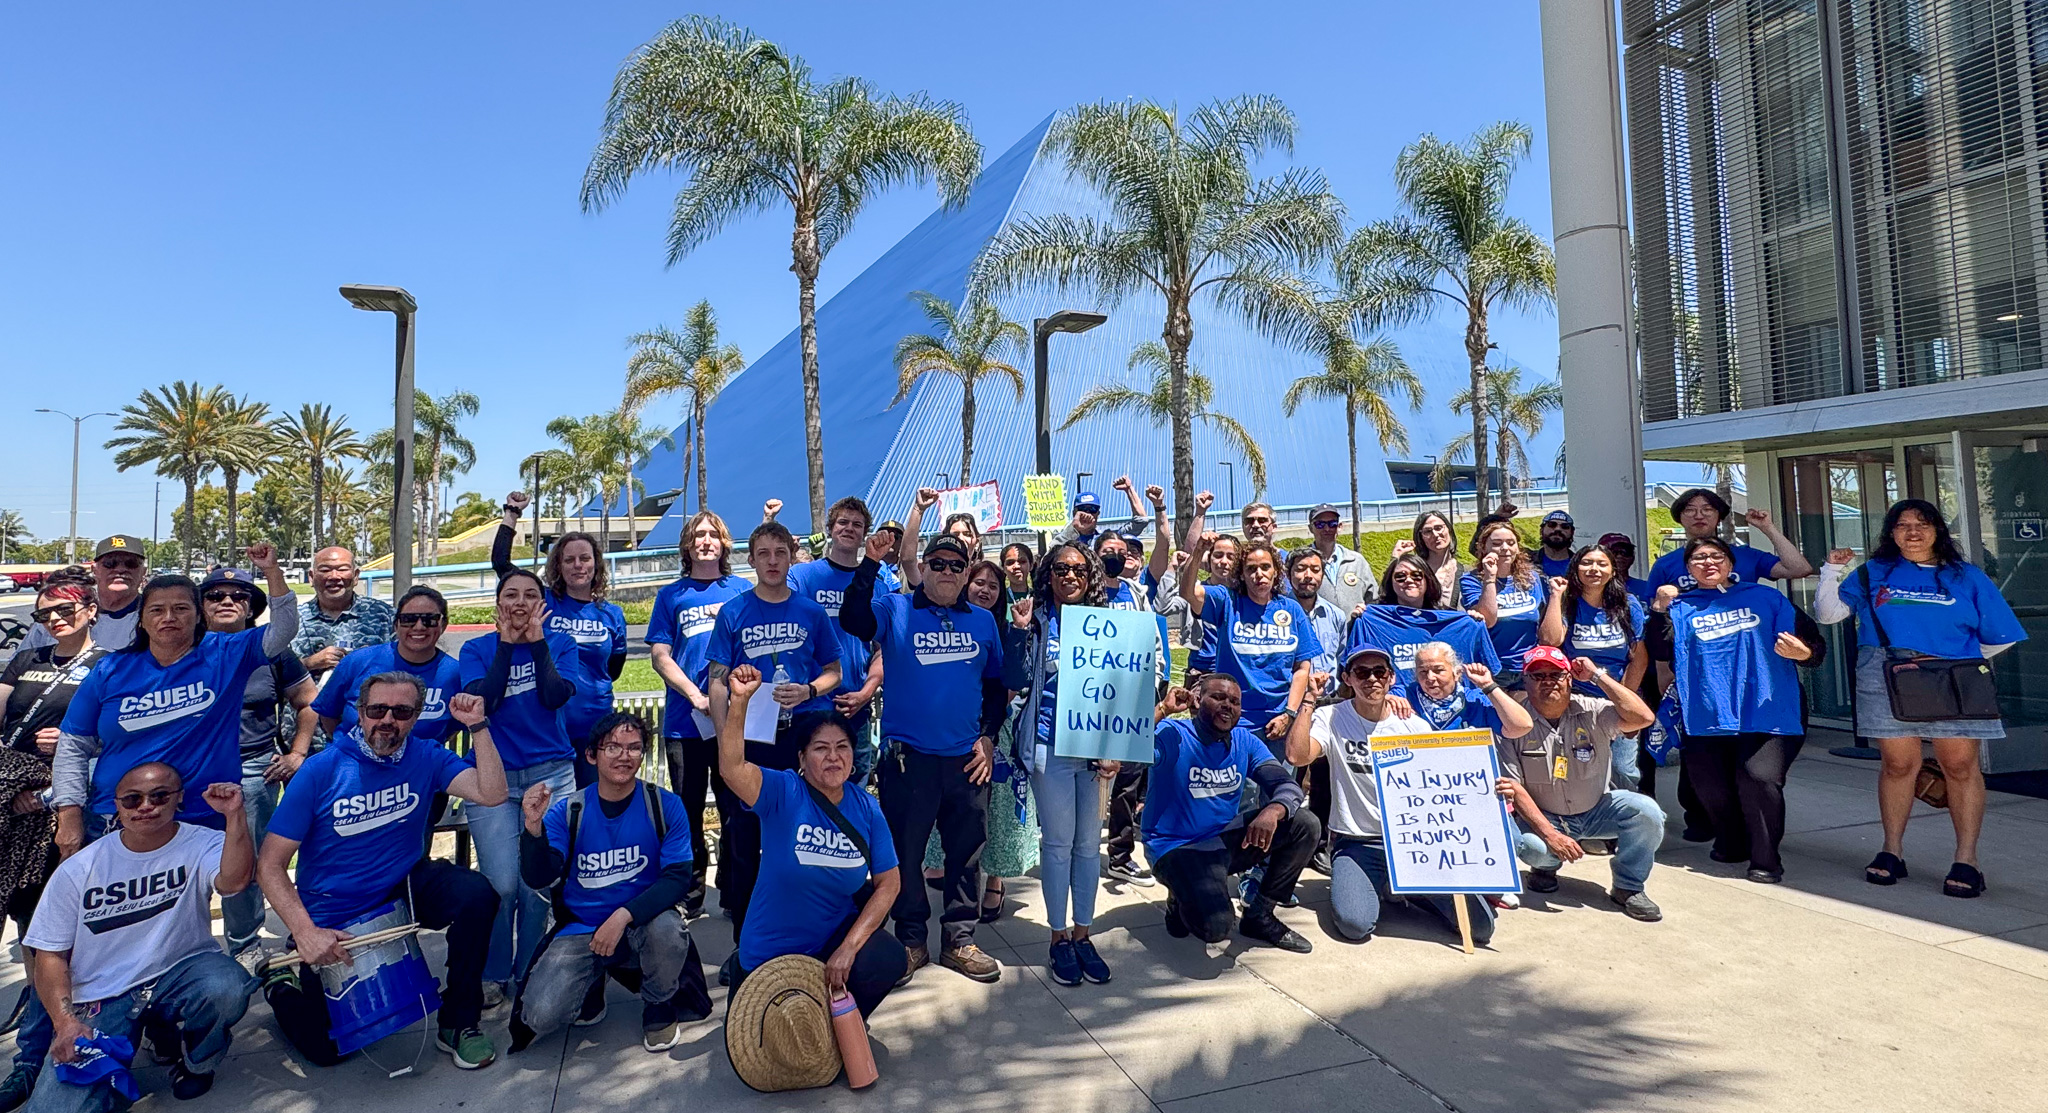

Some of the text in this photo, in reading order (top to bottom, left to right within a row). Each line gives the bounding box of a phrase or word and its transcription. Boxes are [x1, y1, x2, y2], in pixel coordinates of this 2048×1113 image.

[1026, 478, 1059, 490] STAND
[1031, 490, 1056, 501] WITH
[1028, 501, 1063, 512] STUDENT
[1029, 511, 1066, 524] WORKERS
[816, 589, 845, 605] CSU
[1496, 591, 1531, 606] SUEU
[550, 615, 604, 632] CSUEU
[1082, 613, 1118, 641] GO
[1692, 607, 1752, 628] CSUEU
[741, 622, 799, 644] CSUEU
[913, 631, 973, 648] CSUEU
[1233, 620, 1291, 640] CSUEU
[1573, 622, 1622, 638] CSUEU
[1072, 645, 1152, 673] BEACH!
[119, 680, 204, 714] CSUEU
[1082, 676, 1117, 704] GO
[1067, 708, 1150, 739] UNION!
[1397, 738, 1412, 746] State
[1412, 737, 1440, 745] University
[1441, 735, 1473, 744] Employees
[1473, 733, 1492, 741] Union
[1374, 746, 1409, 760] CSUEU
[1189, 764, 1238, 783] CSUEU
[1386, 768, 1490, 796] AN INJURY
[332, 782, 409, 818] CSUEU
[1400, 792, 1468, 808] TO ONE
[1427, 808, 1455, 827] AN
[1397, 826, 1472, 847] INJURY
[577, 844, 640, 872] CSUEU
[1406, 850, 1430, 865] TO
[83, 864, 187, 911] CSUEU
[115, 902, 138, 914] SEIU
[139, 897, 159, 909] Local
